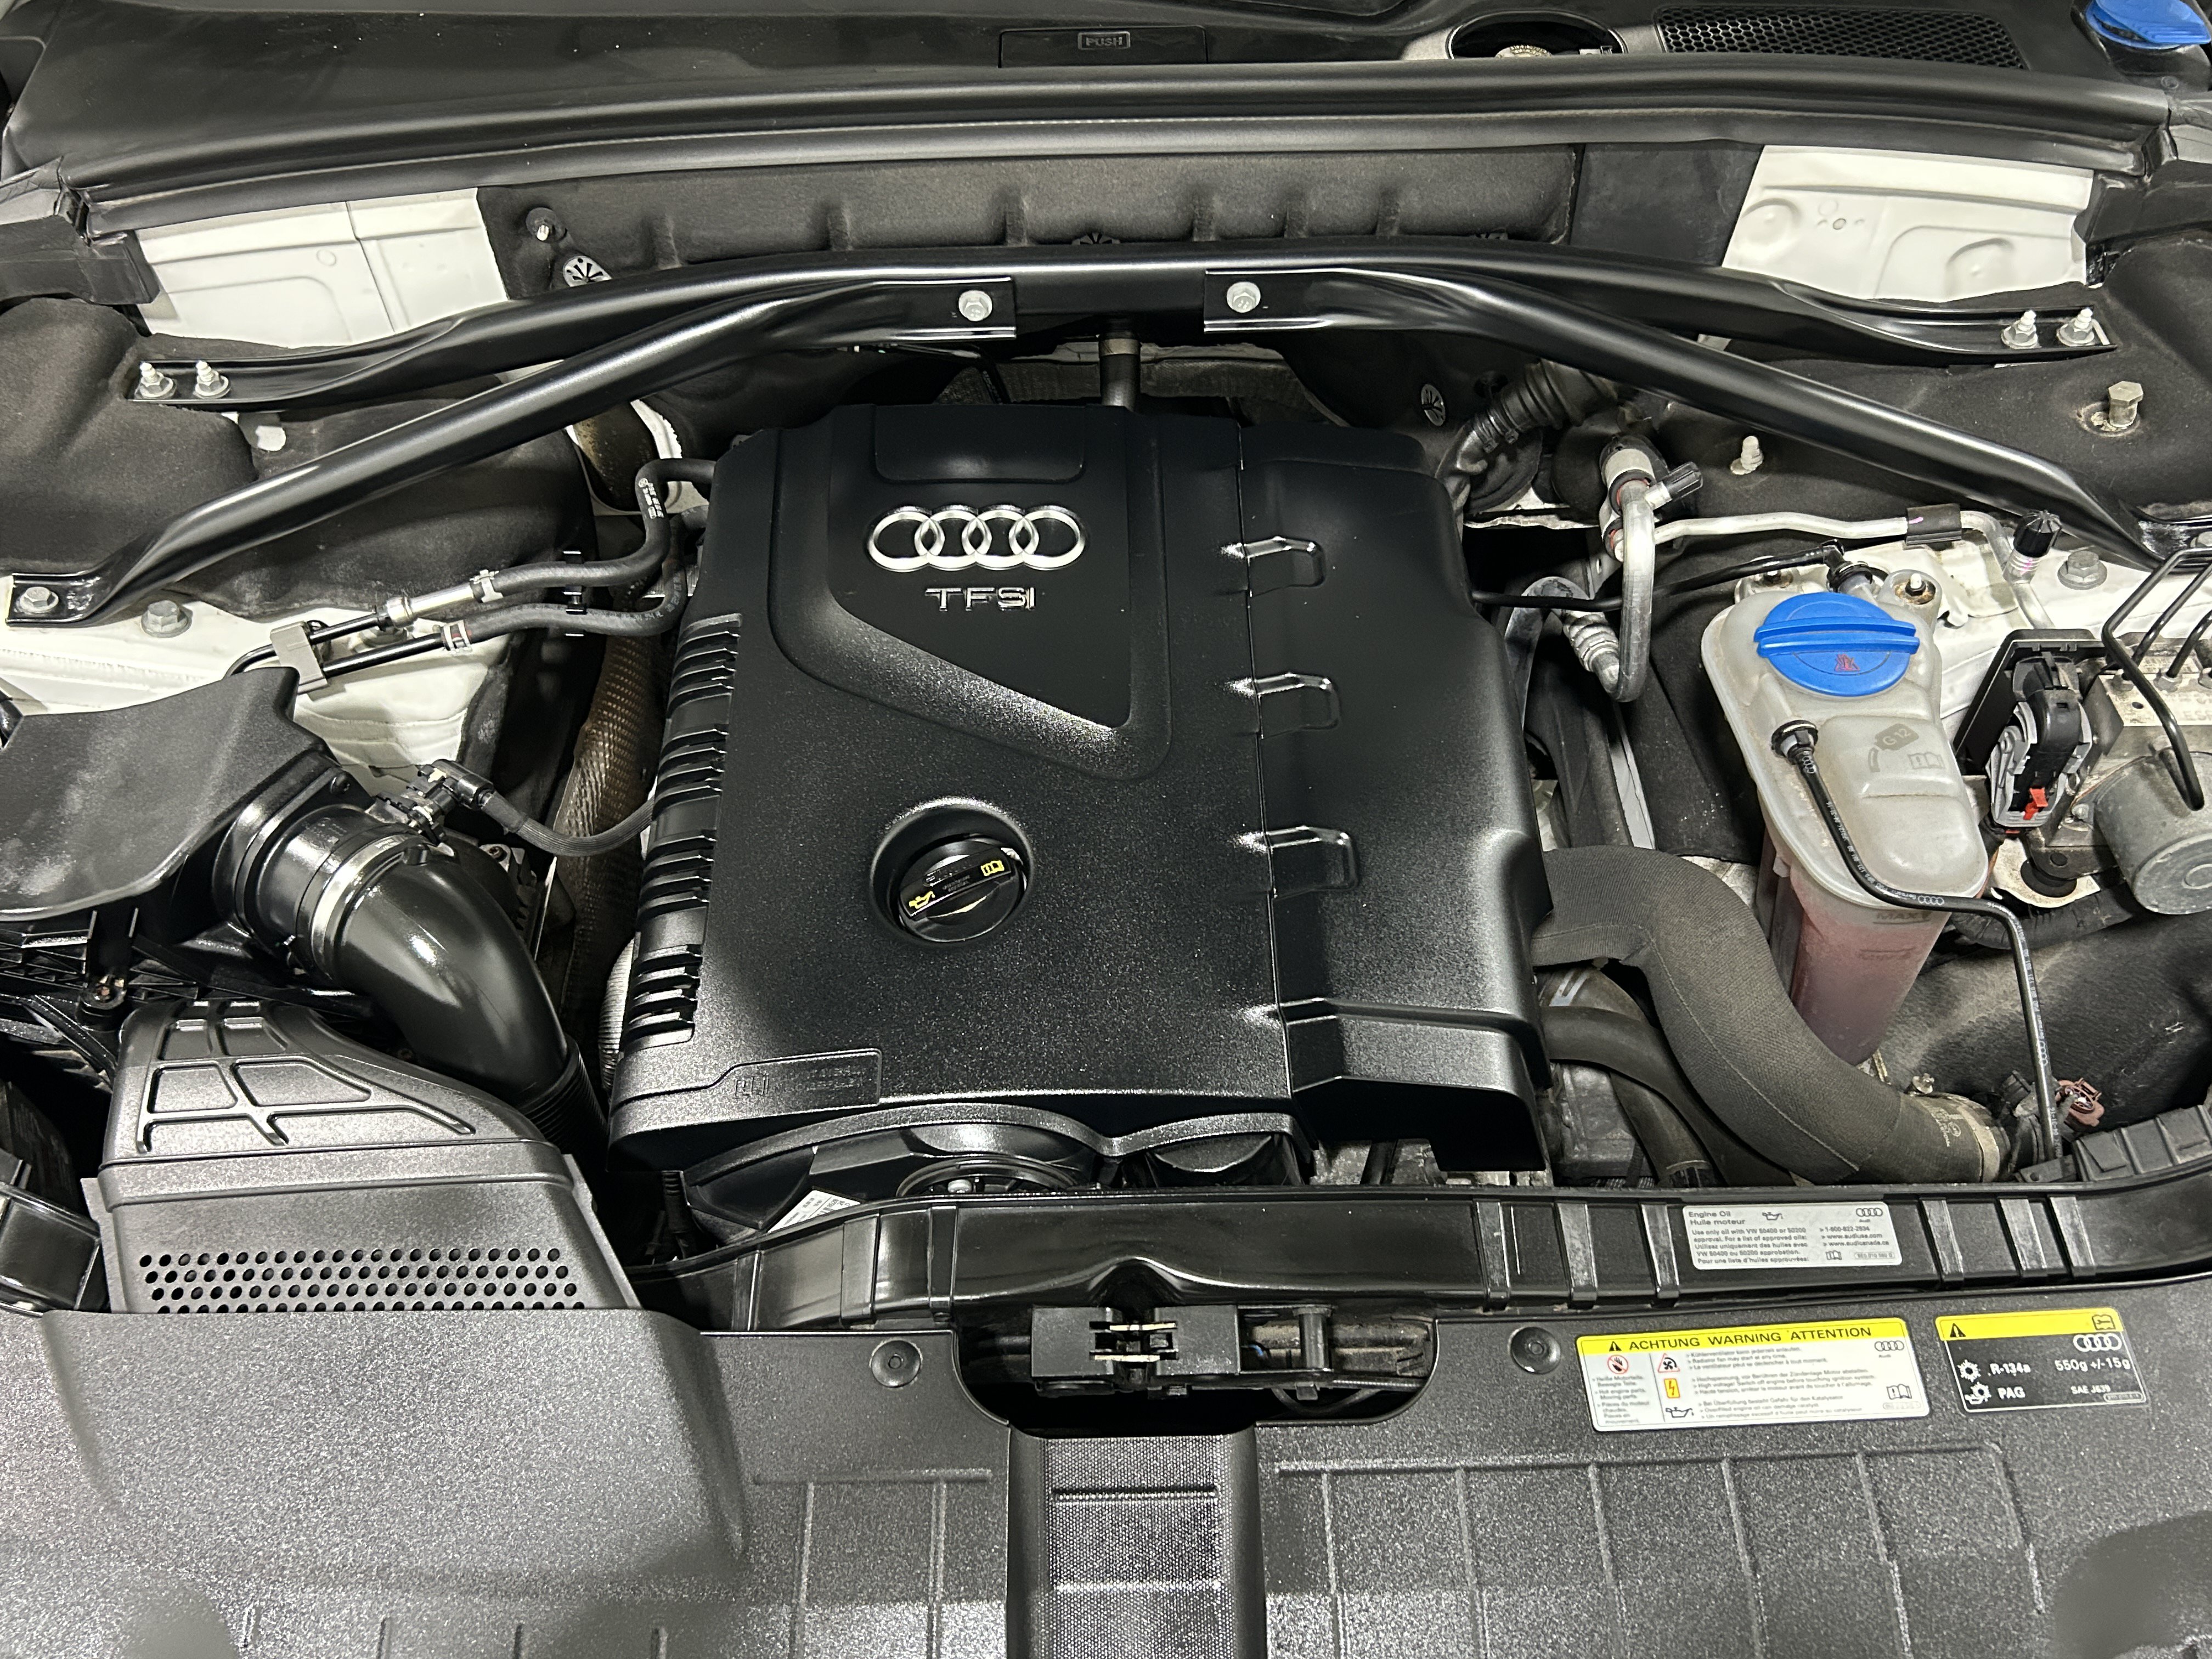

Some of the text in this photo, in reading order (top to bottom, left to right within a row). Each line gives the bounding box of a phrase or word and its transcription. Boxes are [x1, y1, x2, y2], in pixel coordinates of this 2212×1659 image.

[1086, 36, 1123, 47] PUSH
[924, 586, 1037, 612] TFSI
[1629, 1327, 1871, 1351] ACHTUNG WARNING ATTENTION
[1990, 1362, 2031, 1375] R-134a
[2055, 1358, 2088, 1372] 550g
[1997, 1386, 2026, 1400] PAG
[2071, 1385, 2089, 1395] SAE
